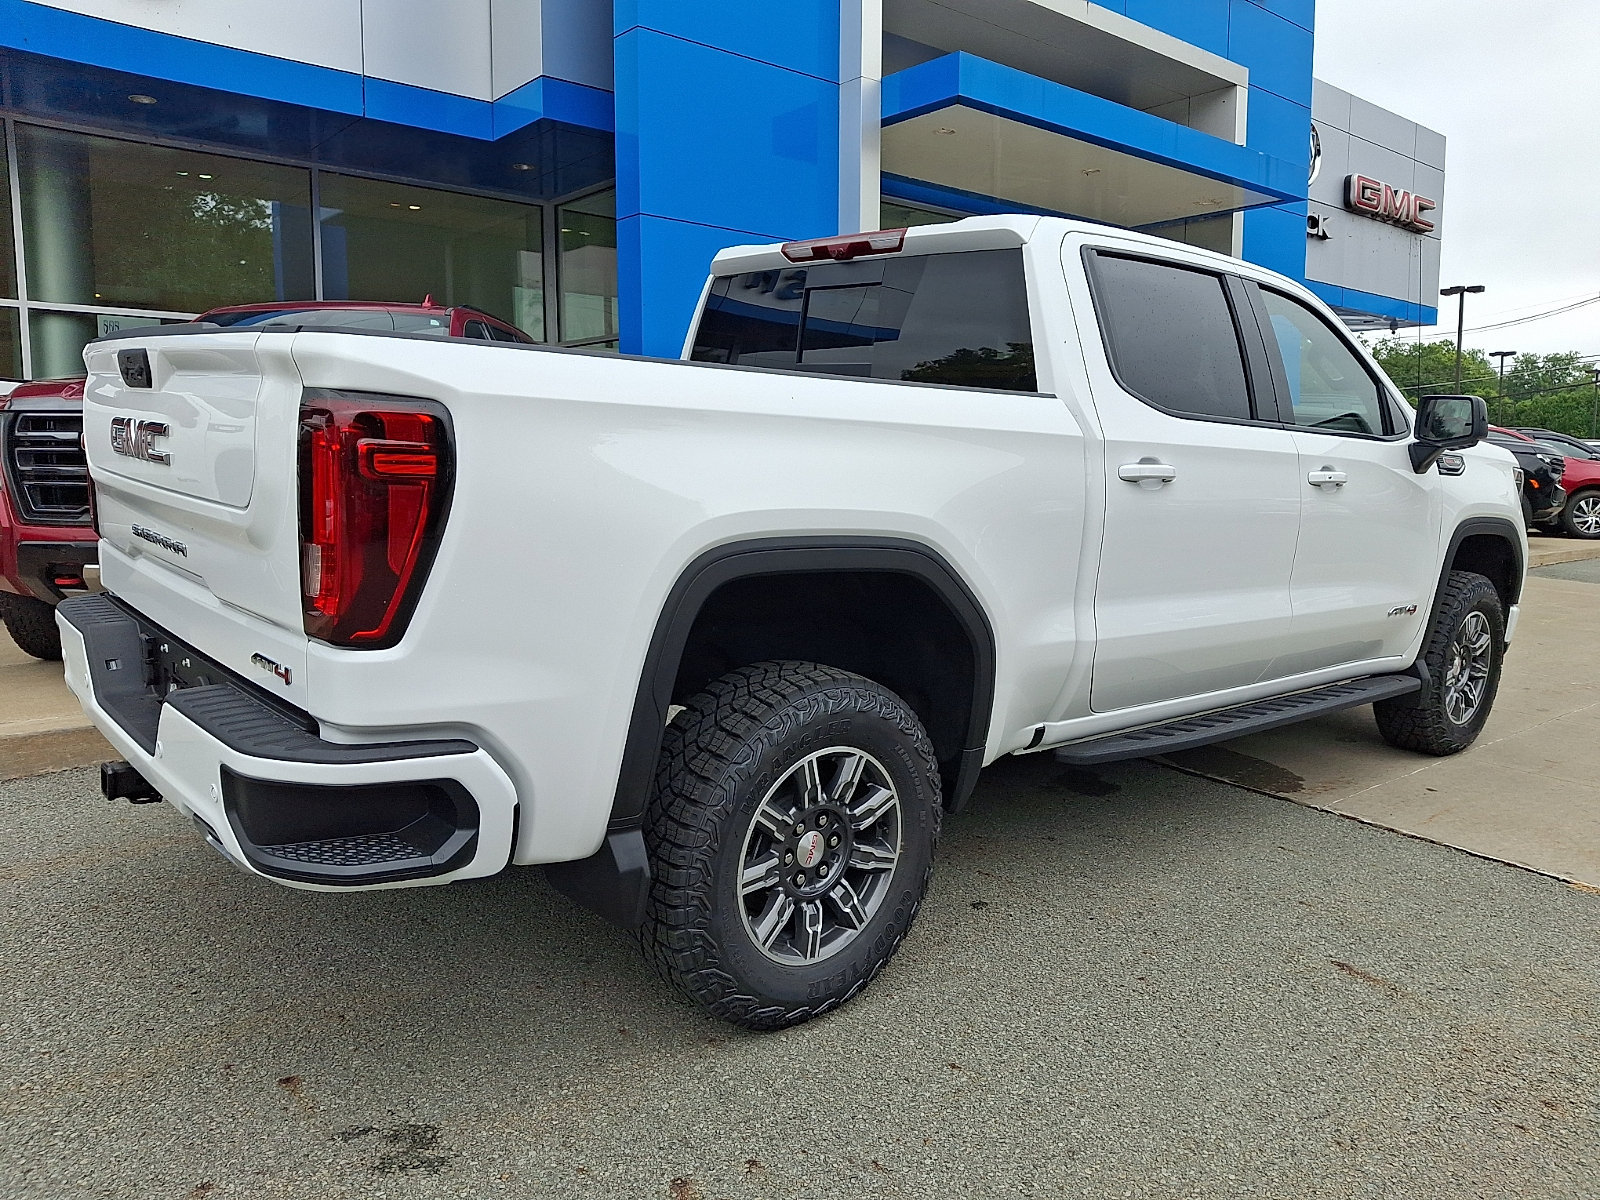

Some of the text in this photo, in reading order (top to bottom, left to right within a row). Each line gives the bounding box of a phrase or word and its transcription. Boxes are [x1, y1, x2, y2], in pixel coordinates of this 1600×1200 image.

[1350, 174, 1436, 233] GMC
[111, 417, 172, 467] GMC
[131, 523, 188, 558] SIERRA
[740, 719, 851, 815] WRANGLER
[805, 834, 818, 865] GMC
[806, 890, 913, 999] GOODYEAR
